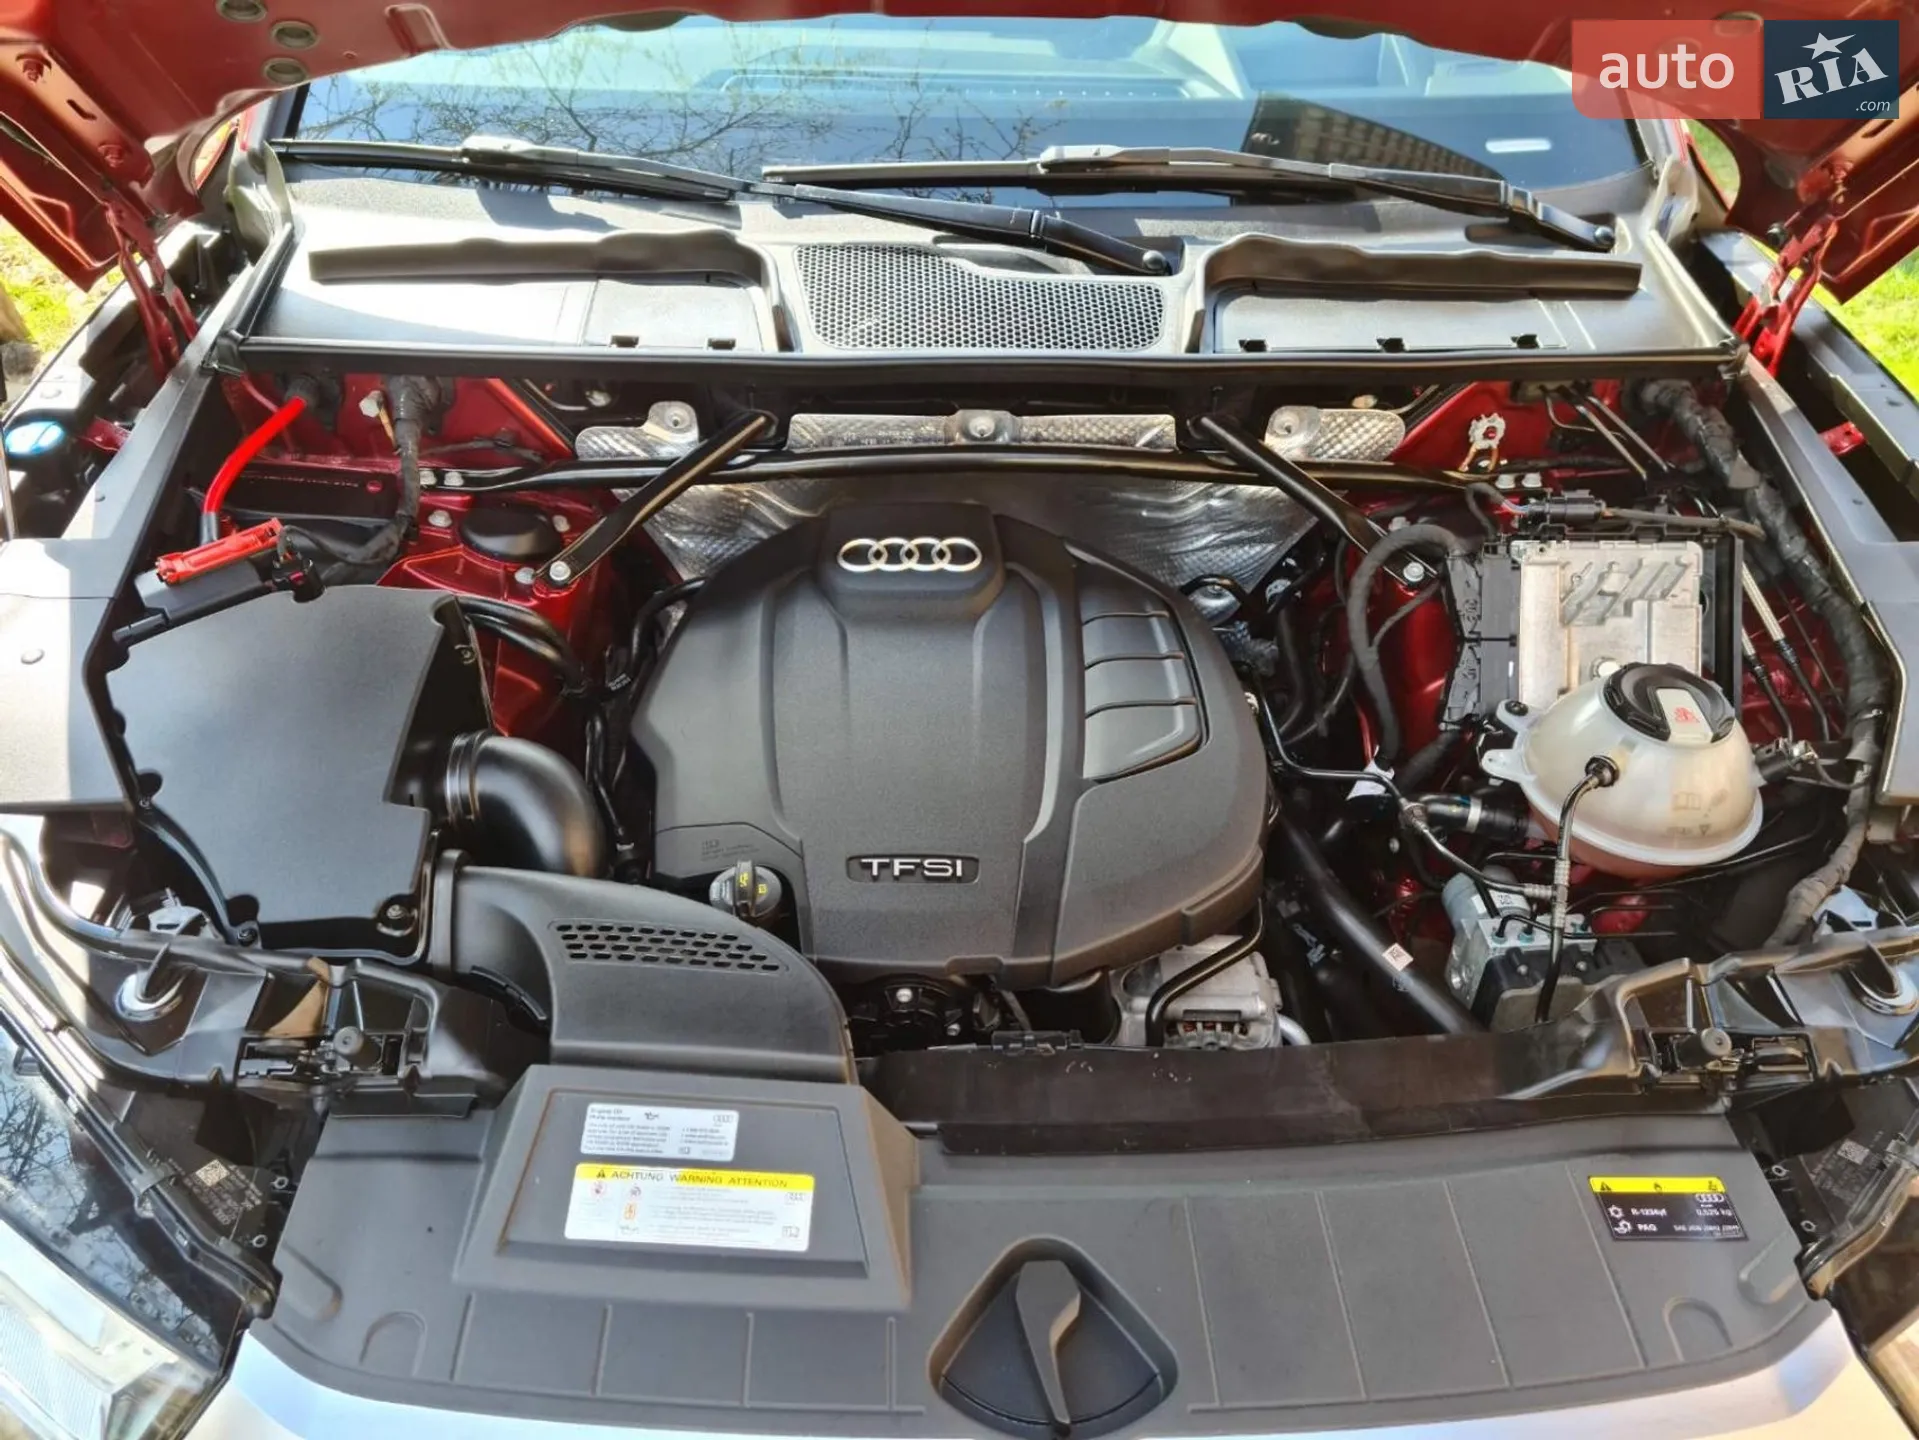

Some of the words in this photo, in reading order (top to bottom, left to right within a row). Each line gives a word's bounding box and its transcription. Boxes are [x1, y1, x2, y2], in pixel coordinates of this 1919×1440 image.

[860, 858, 962, 877] TFSI
[612, 1171, 664, 1182] ACHTUNG
[669, 1174, 723, 1185] WARNING
[728, 1176, 788, 1188] ATTENTION
